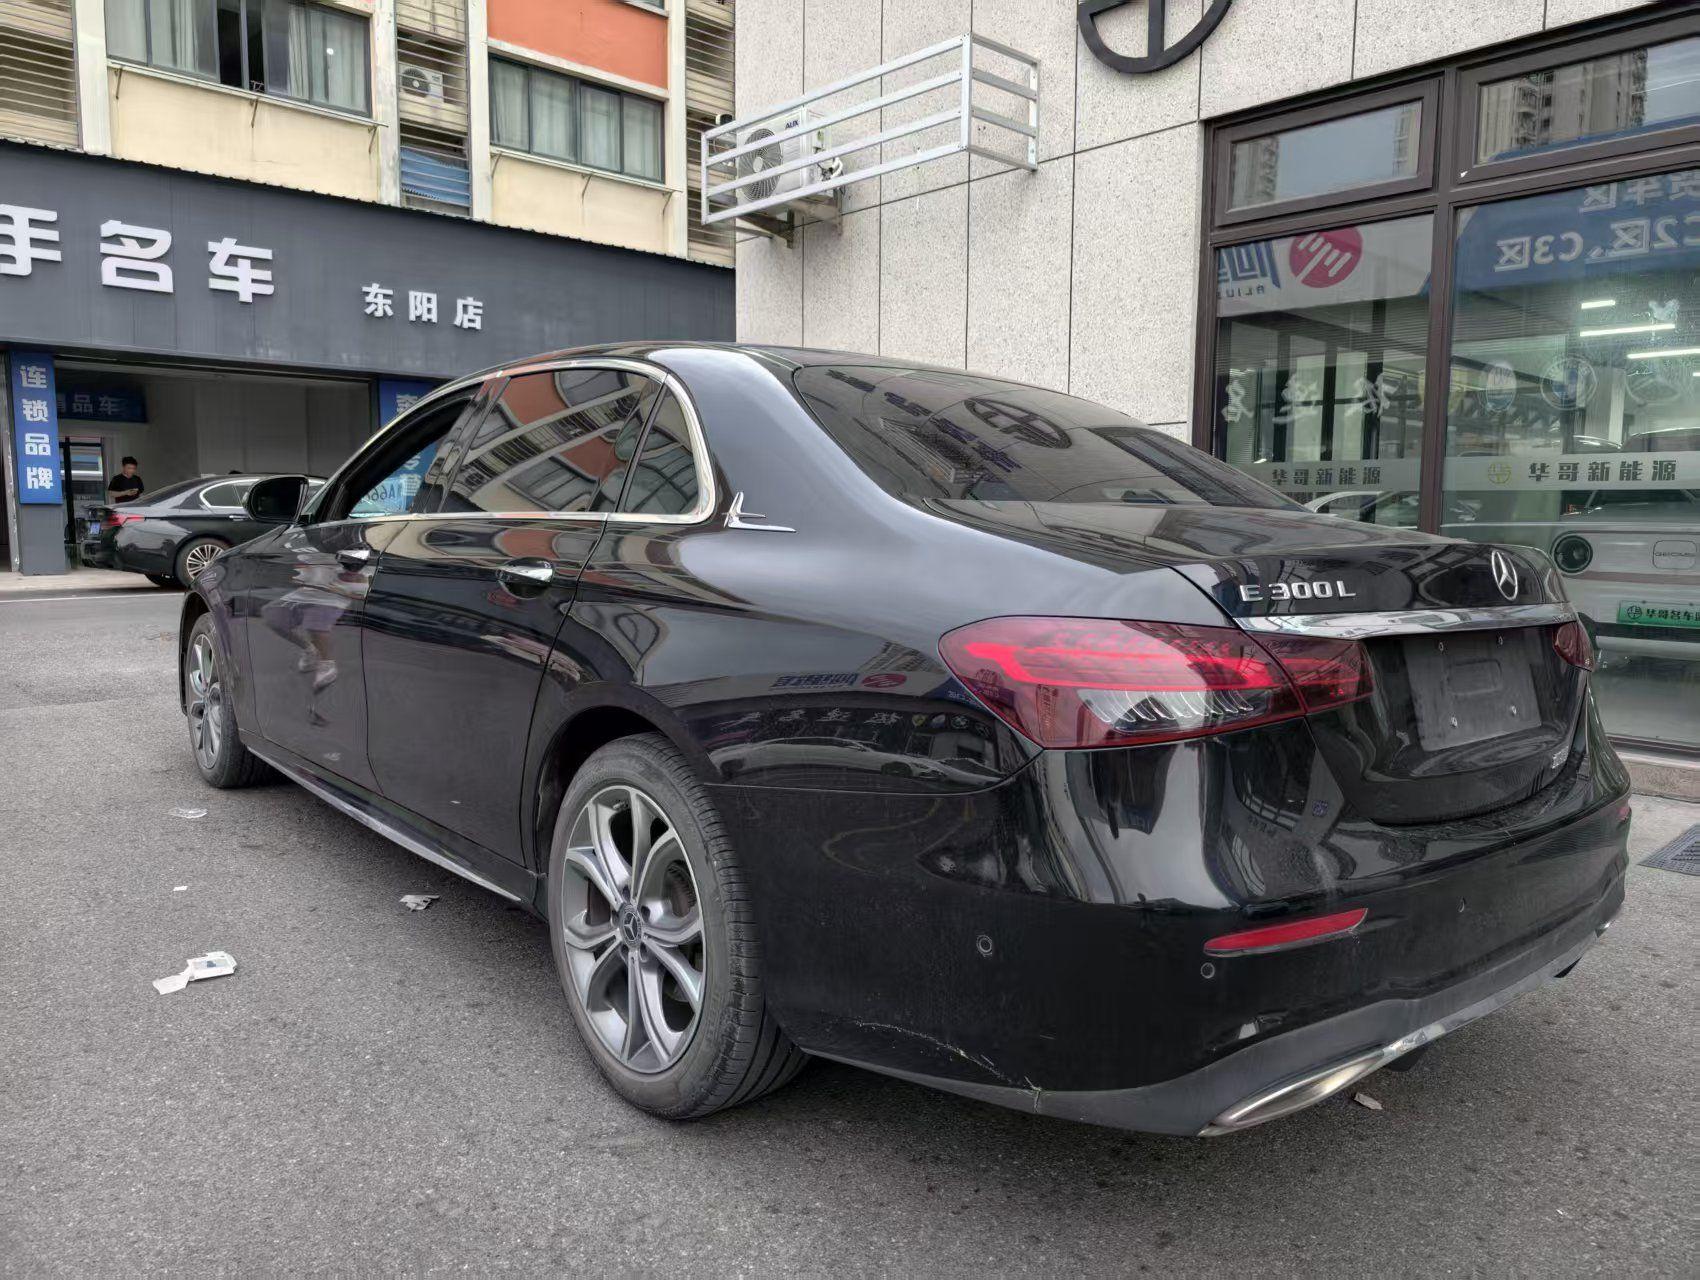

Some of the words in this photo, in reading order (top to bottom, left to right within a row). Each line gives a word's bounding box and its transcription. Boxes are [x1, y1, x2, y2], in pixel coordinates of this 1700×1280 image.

[785, 120, 799, 130] AUX
[362, 283, 484, 330] 东阳店
[19, 365, 54, 490] 连锁品牌
[1271, 466, 1381, 486] 华哥新能源
[1528, 459, 1677, 482] 华哥新能源
